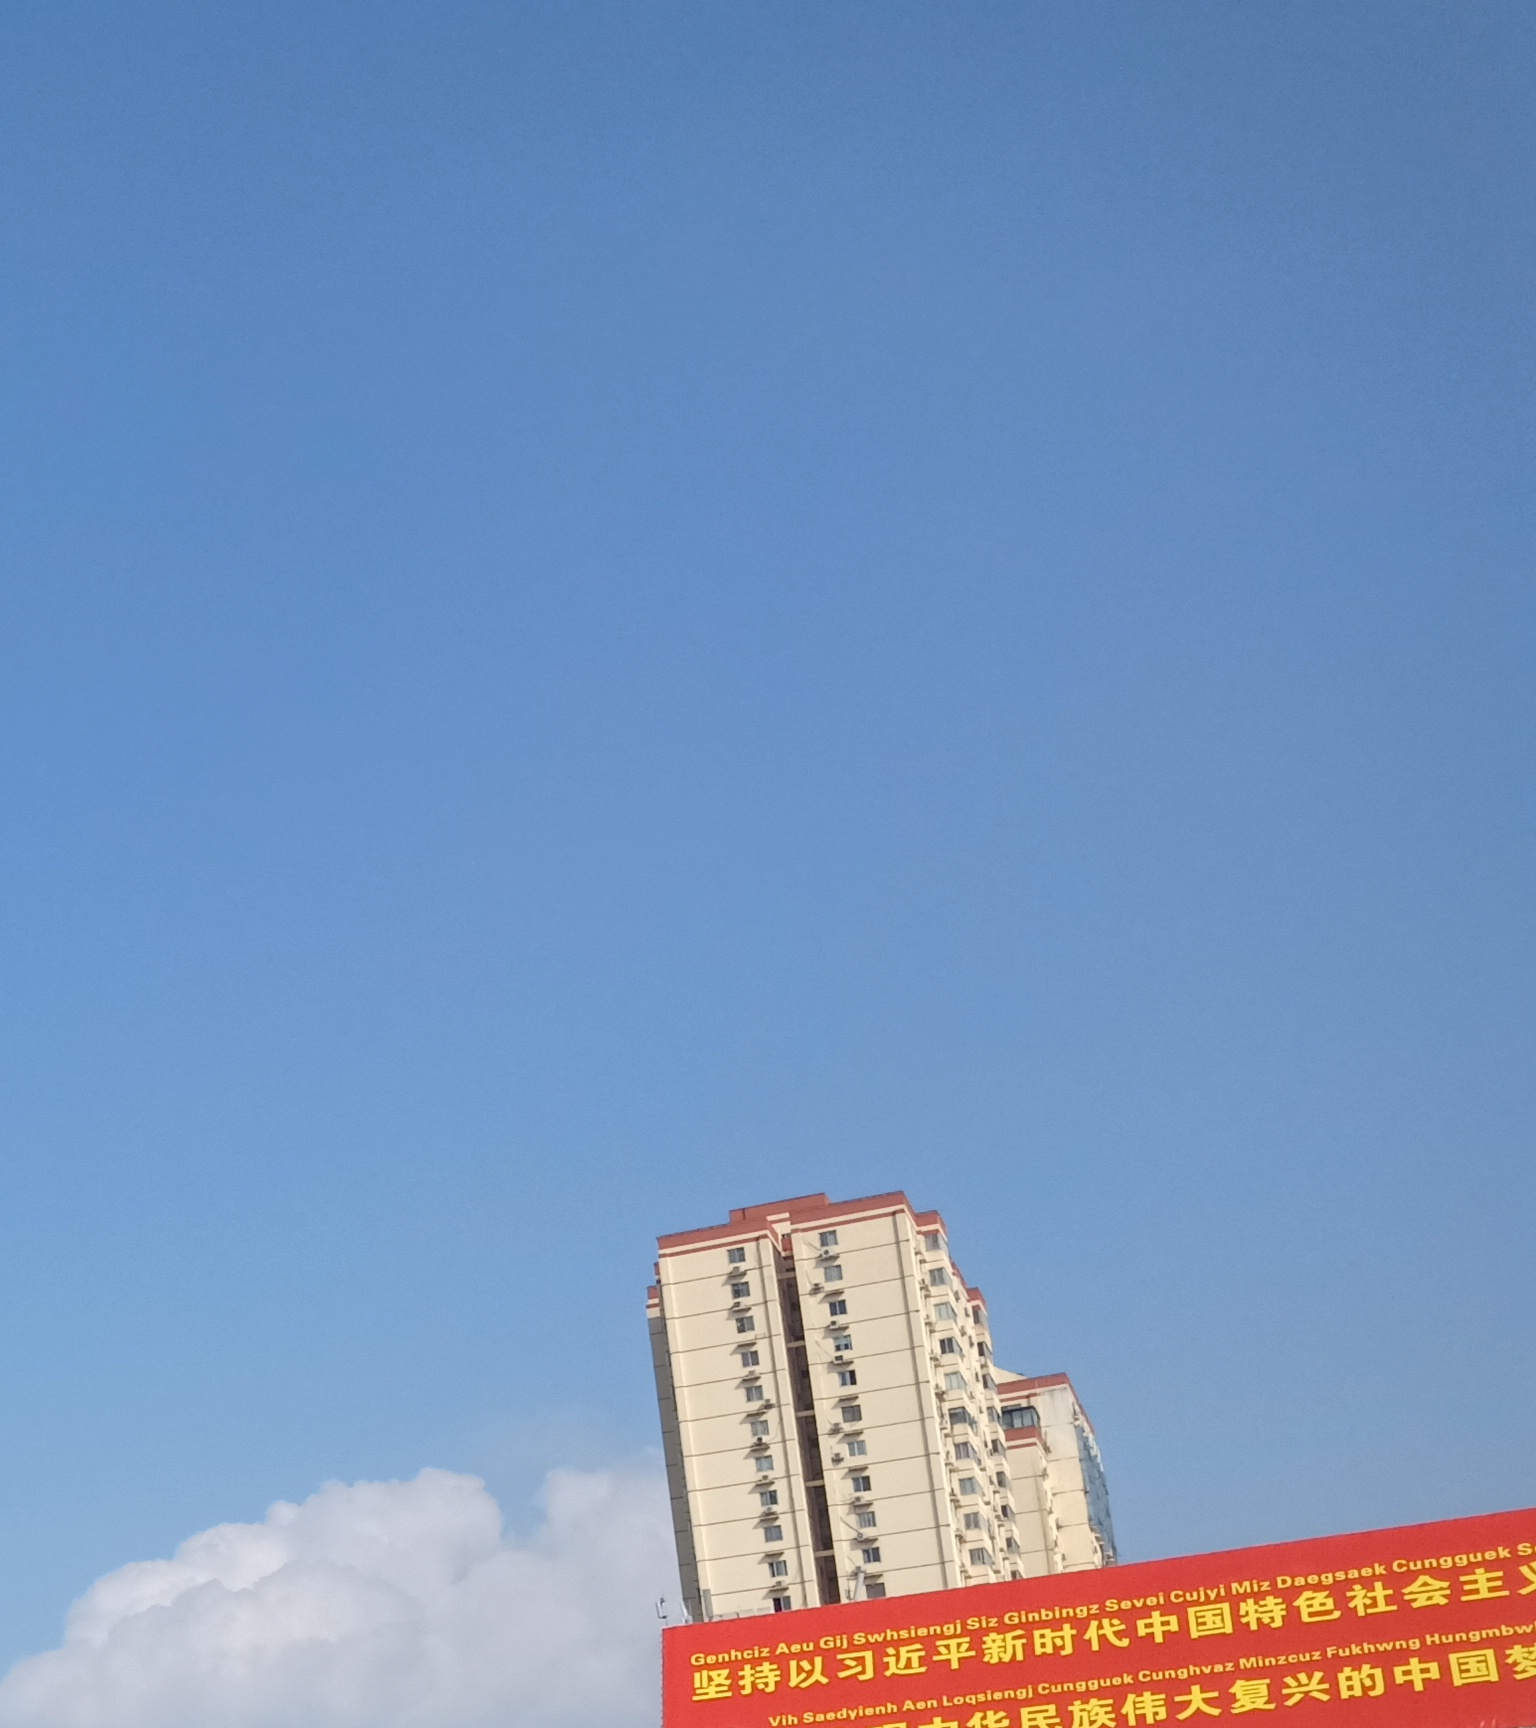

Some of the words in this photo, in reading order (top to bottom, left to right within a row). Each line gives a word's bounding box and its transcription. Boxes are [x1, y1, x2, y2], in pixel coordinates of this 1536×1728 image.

[690, 1646, 770, 1666] Genhciz
[775, 1641, 815, 1655] Aeu
[819, 1634, 849, 1649] Gij
[853, 1619, 962, 1645] Swhsiengj
[966, 1616, 999, 1630] Siz
[1003, 1603, 1100, 1625] Ginbingz
[1105, 1592, 1166, 1612] Sevei
[1169, 1584, 1226, 1603] Cujyi
[1231, 1579, 1271, 1595] Miz
[1276, 1562, 1386, 1589] Daegsaek
[1392, 1546, 1512, 1573] Cungguek
[768, 1713, 798, 1728] Vih
[803, 1701, 898, 1724] Saedyienh
[902, 1697, 938, 1712] Aen
[942, 1684, 1033, 1707] Loqsiengj
[1037, 1672, 1134, 1695] Cungguek
[1138, 1660, 1235, 1683] Cunghvaz
[1239, 1650, 1322, 1670] Minzcuz
[1326, 1636, 1421, 1660] Fukhwng
[1425, 1620, 1536, 1647] Hungmbw
